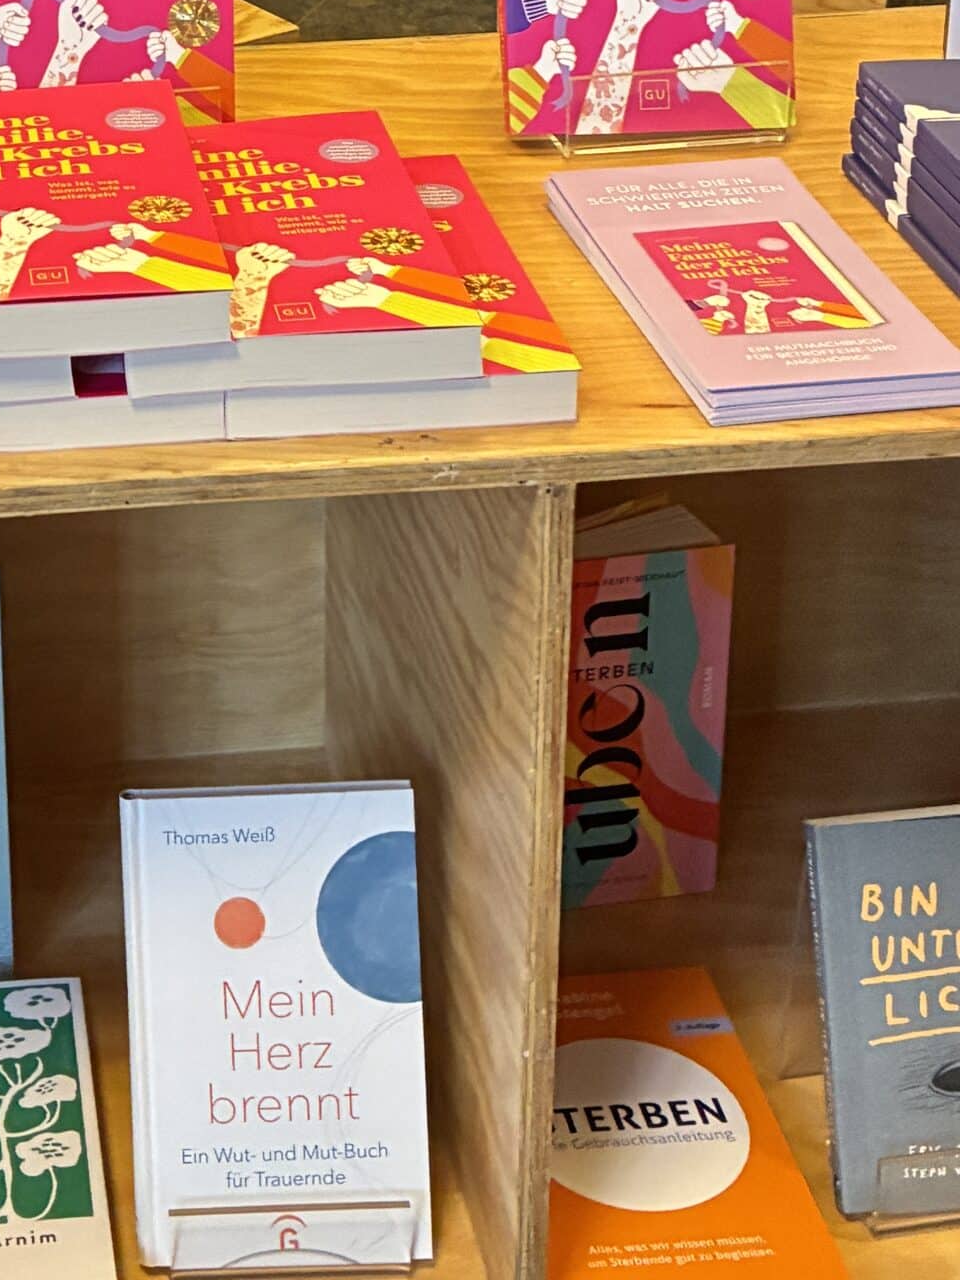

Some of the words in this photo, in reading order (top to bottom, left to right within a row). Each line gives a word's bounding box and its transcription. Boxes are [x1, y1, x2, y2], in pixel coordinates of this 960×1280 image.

[644, 88, 666, 102] GU
[1, 141, 145, 163] Krebs
[194, 147, 265, 164] ine
[17, 159, 93, 179] ich
[222, 172, 366, 195] Krebs
[605, 184, 641, 194] FÜR
[698, 177, 726, 188] DIE
[733, 176, 753, 186] IN
[241, 193, 316, 213] ich
[587, 188, 717, 206] SCHWIERIGEN
[719, 184, 785, 195] ZEITEN
[625, 201, 672, 213] HALT
[660, 240, 733, 255] Meine
[675, 261, 714, 272] der
[719, 254, 790, 268] Krebs
[35, 270, 63, 281] GU
[682, 267, 729, 280] und
[282, 305, 311, 317] GU
[573, 661, 655, 683] TERBEN
[163, 829, 229, 846] Thomas
[232, 827, 276, 844] Weiß
[861, 882, 938, 921] BIN
[223, 979, 335, 1021] Mein
[885, 985, 960, 1026] LIC
[230, 1032, 332, 1073] Herz
[209, 1083, 360, 1124] brennt
[182, 1147, 209, 1165] Ein
[213, 1146, 257, 1164] Wut-
[262, 1144, 297, 1163] und
[302, 1142, 389, 1162] Mut-Buch
[226, 1171, 252, 1189] für
[254, 1169, 348, 1188] Trauernde
[624, 1244, 649, 1253] was
[610, 1253, 673, 1268] Sterbende
[675, 1253, 696, 1266] gut
